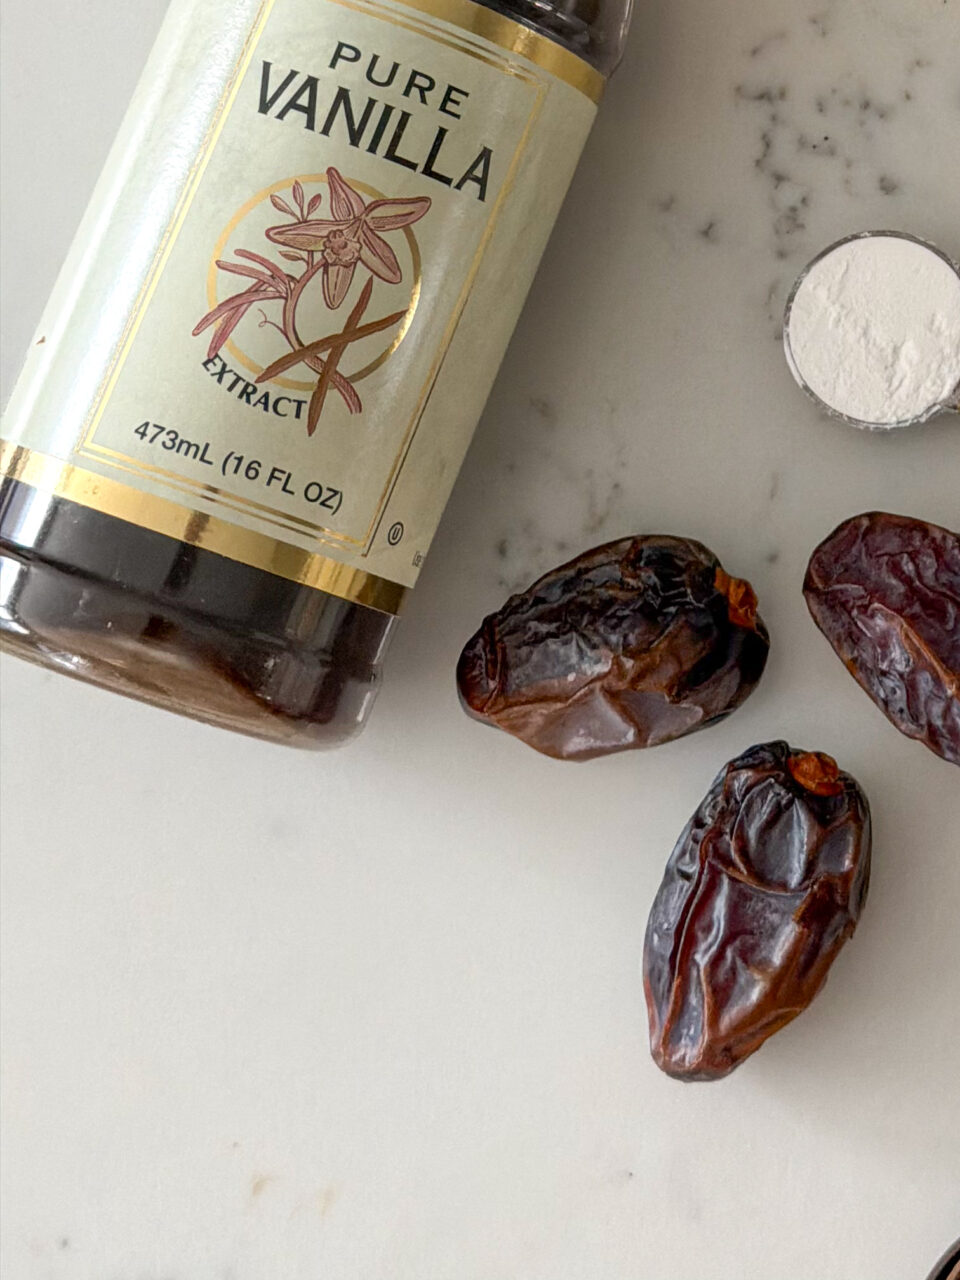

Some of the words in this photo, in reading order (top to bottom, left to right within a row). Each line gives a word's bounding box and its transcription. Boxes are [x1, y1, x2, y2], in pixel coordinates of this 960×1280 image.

[327, 40, 470, 120] PURE
[257, 59, 494, 203] VANILLA
[201, 353, 308, 420] EXTRACT
[134, 420, 214, 466] 473mL
[221, 450, 262, 481] (16
[265, 466, 296, 496] FL
[303, 481, 344, 516] OZ)
